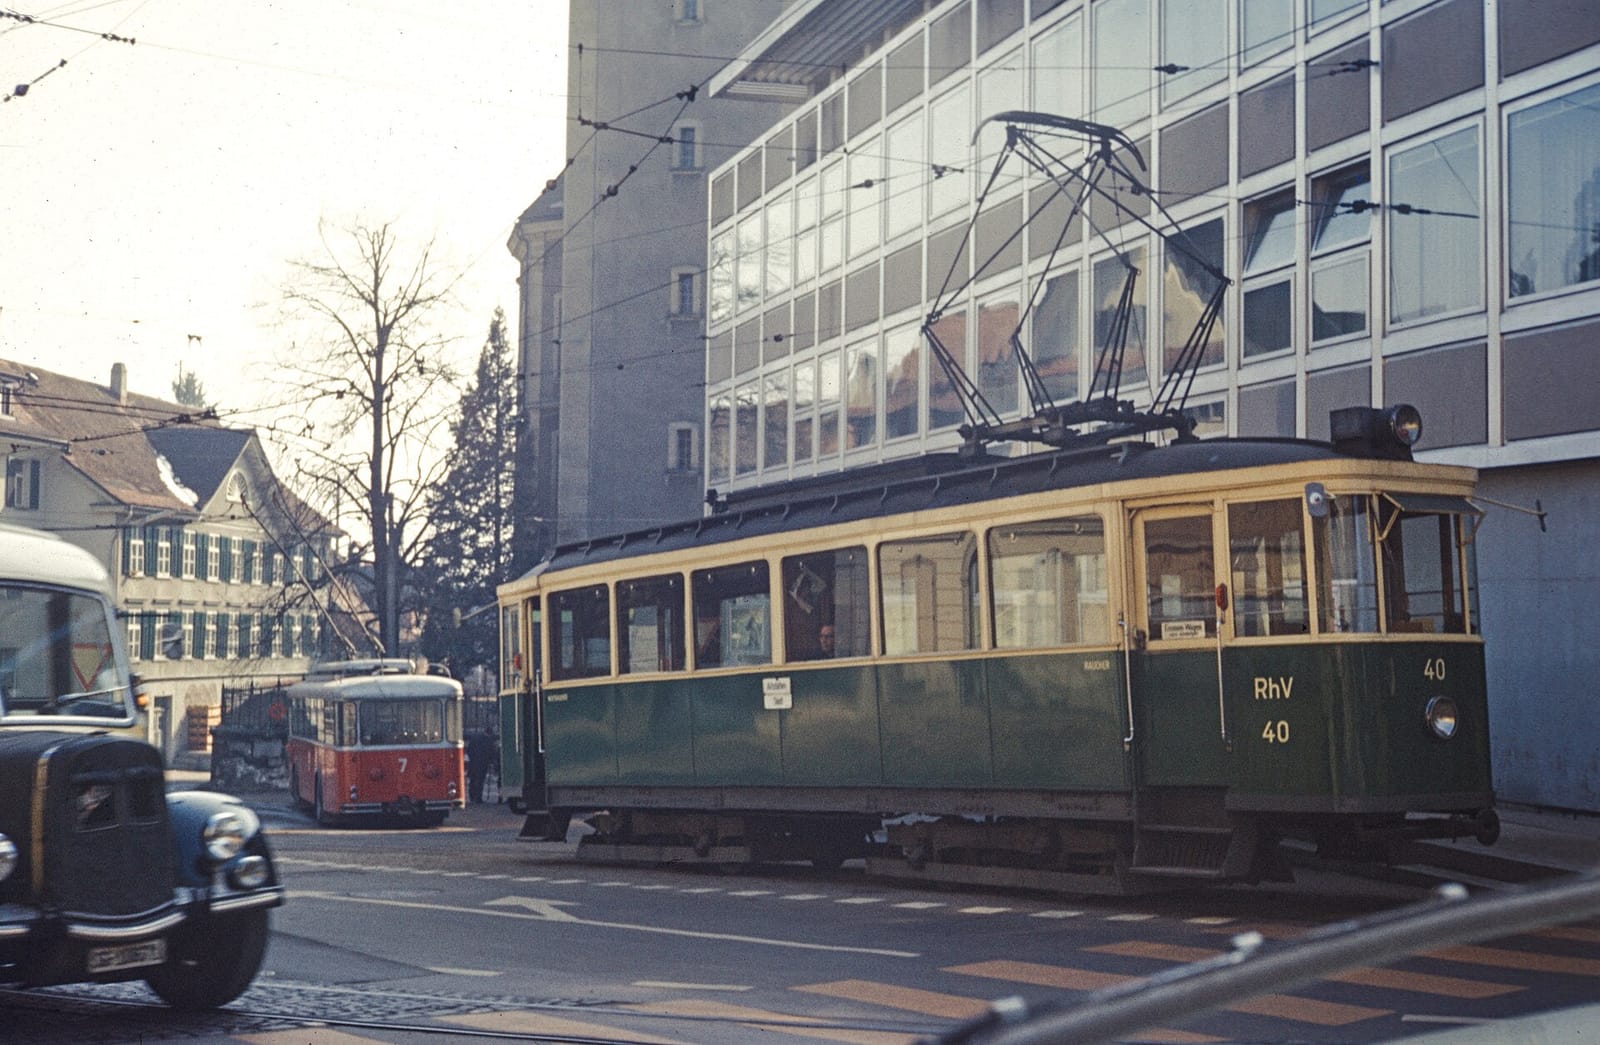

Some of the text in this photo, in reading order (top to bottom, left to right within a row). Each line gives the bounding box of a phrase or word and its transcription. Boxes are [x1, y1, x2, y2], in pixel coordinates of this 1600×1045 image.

[1424, 657, 1446, 681] 40
[1253, 676, 1294, 700] RhV
[1261, 719, 1290, 743] 40
[398, 758, 408, 773] 7
